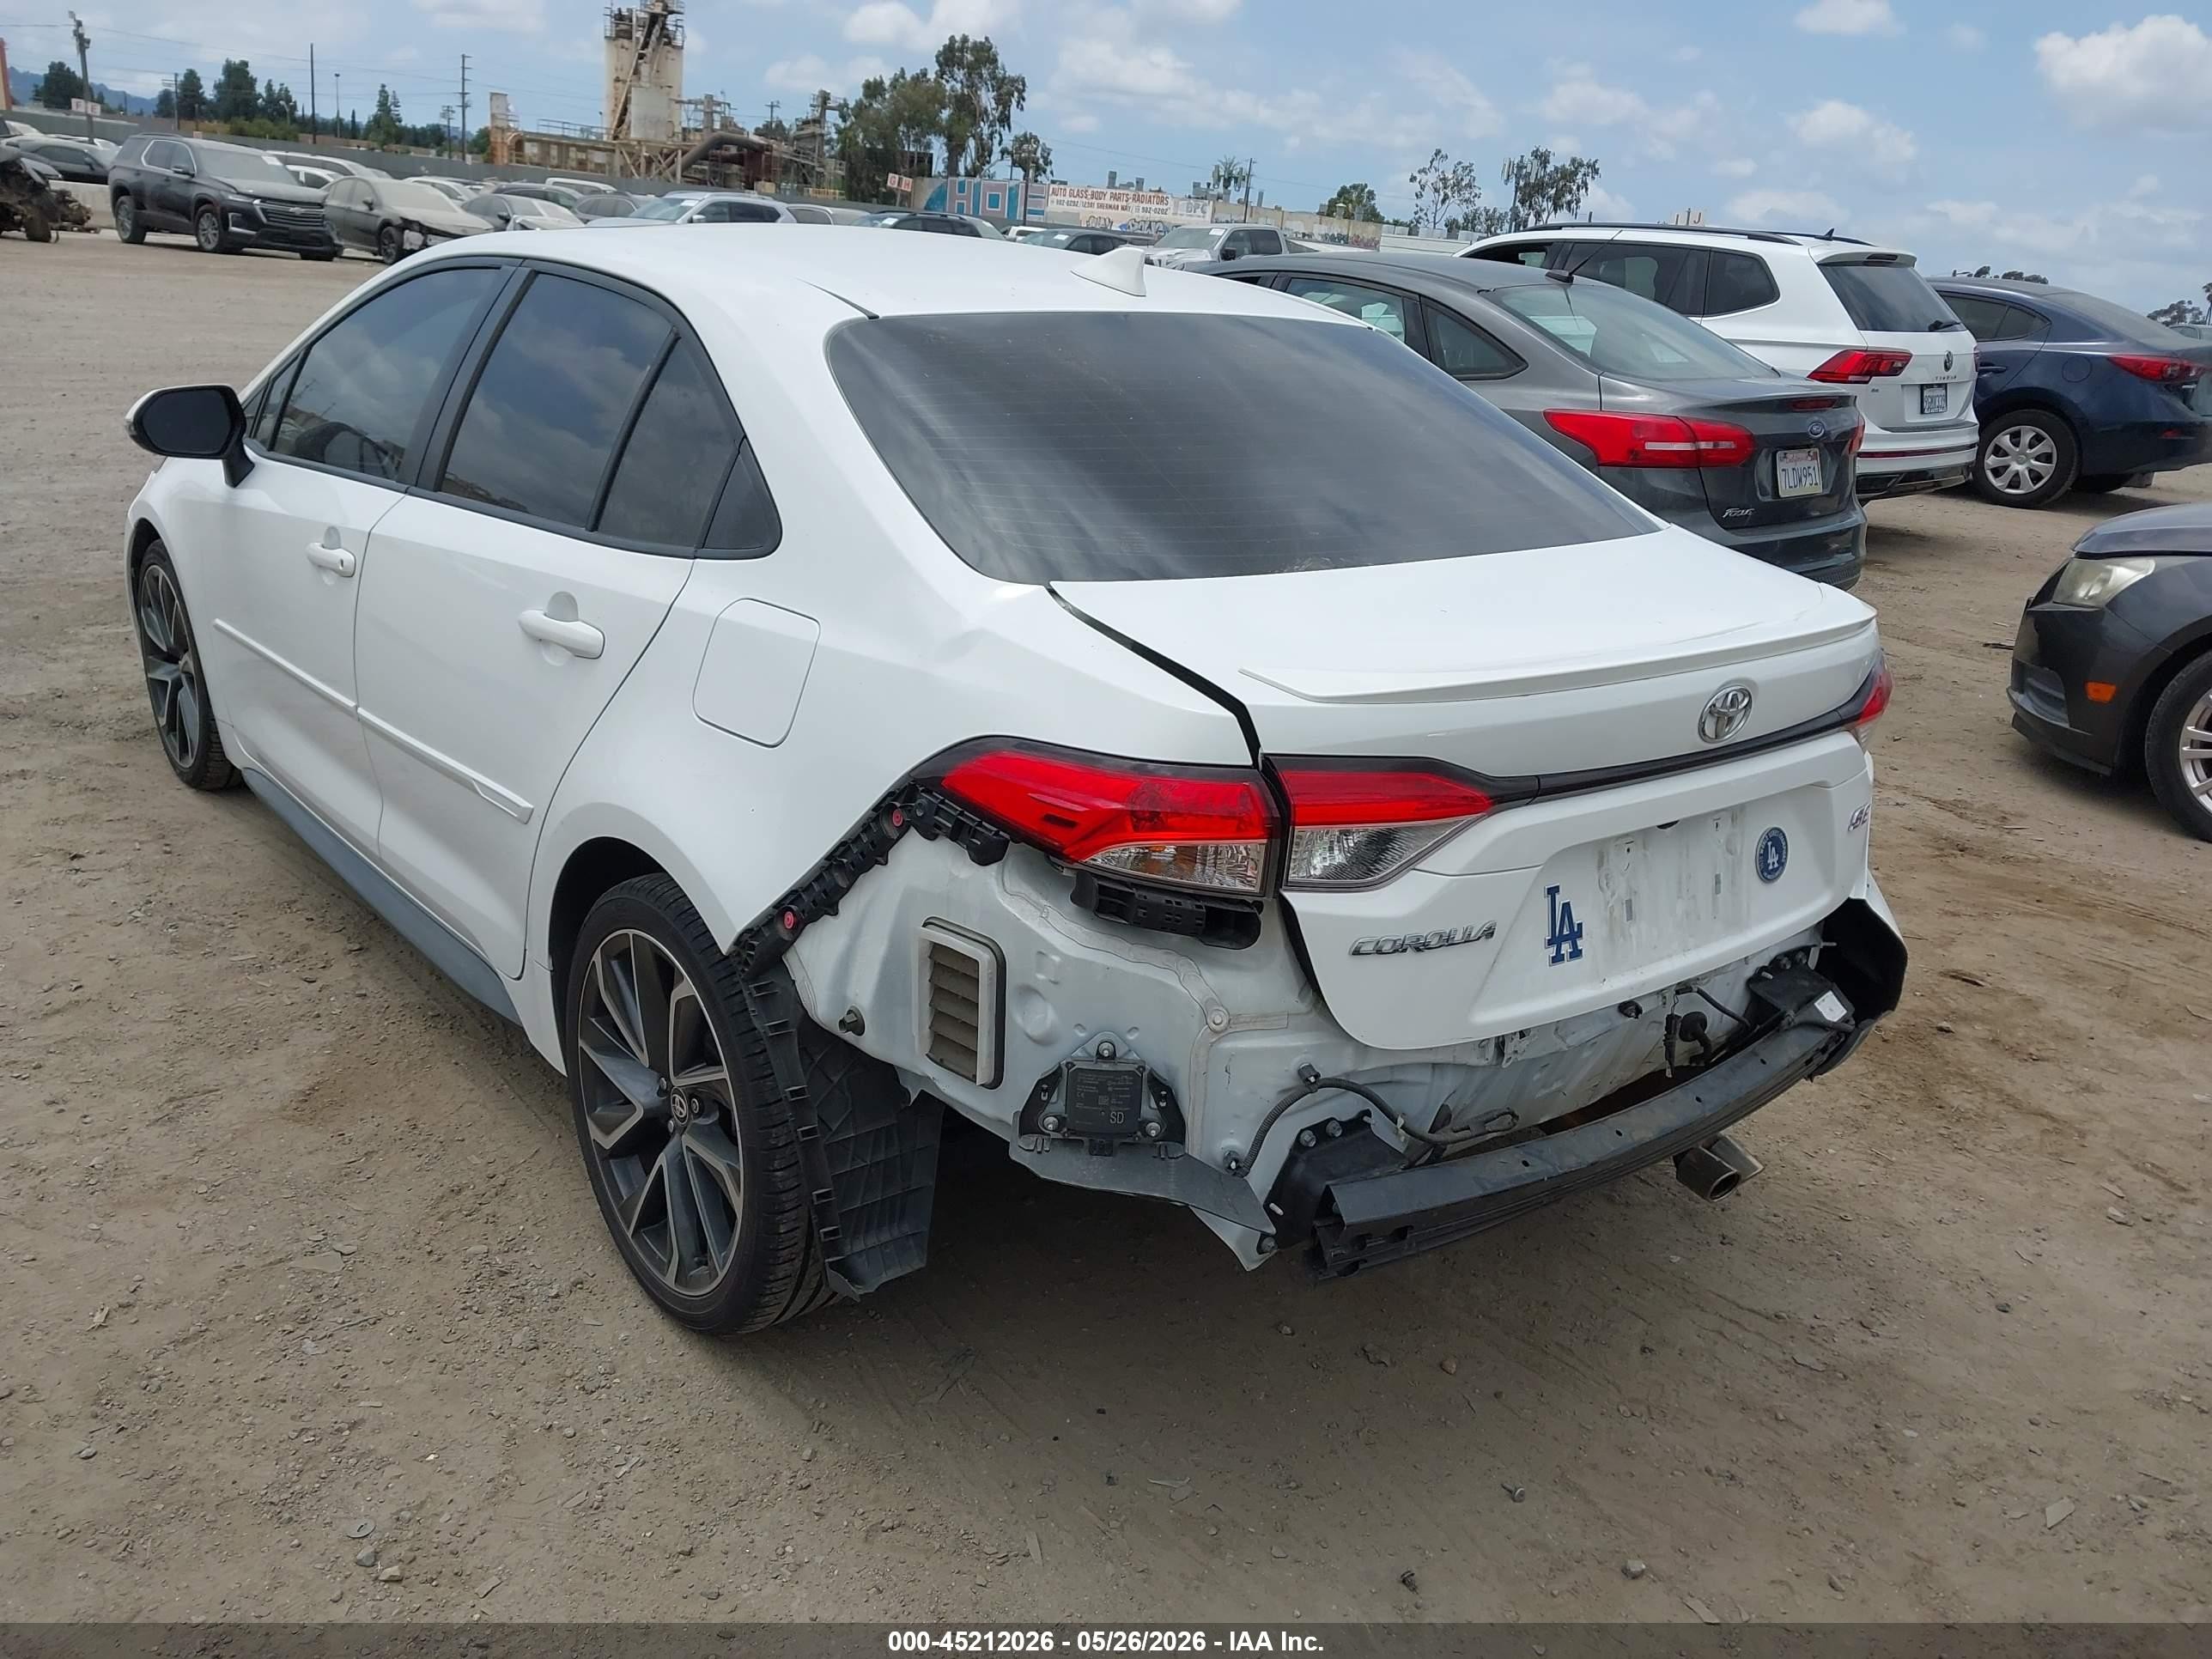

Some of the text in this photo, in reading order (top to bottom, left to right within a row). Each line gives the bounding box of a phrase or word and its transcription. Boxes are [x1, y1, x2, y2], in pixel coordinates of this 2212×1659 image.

[889, 175, 896, 187] G
[1051, 186, 1066, 197] AUTO
[1097, 202, 1120, 211] SHERMAN
[1781, 465, 1819, 489] 7LDW951
[1767, 841, 1779, 870] LA
[1543, 883, 1583, 967] LA
[1348, 920, 1498, 956] COROLLA
[1109, 1111, 1125, 1124] SD
